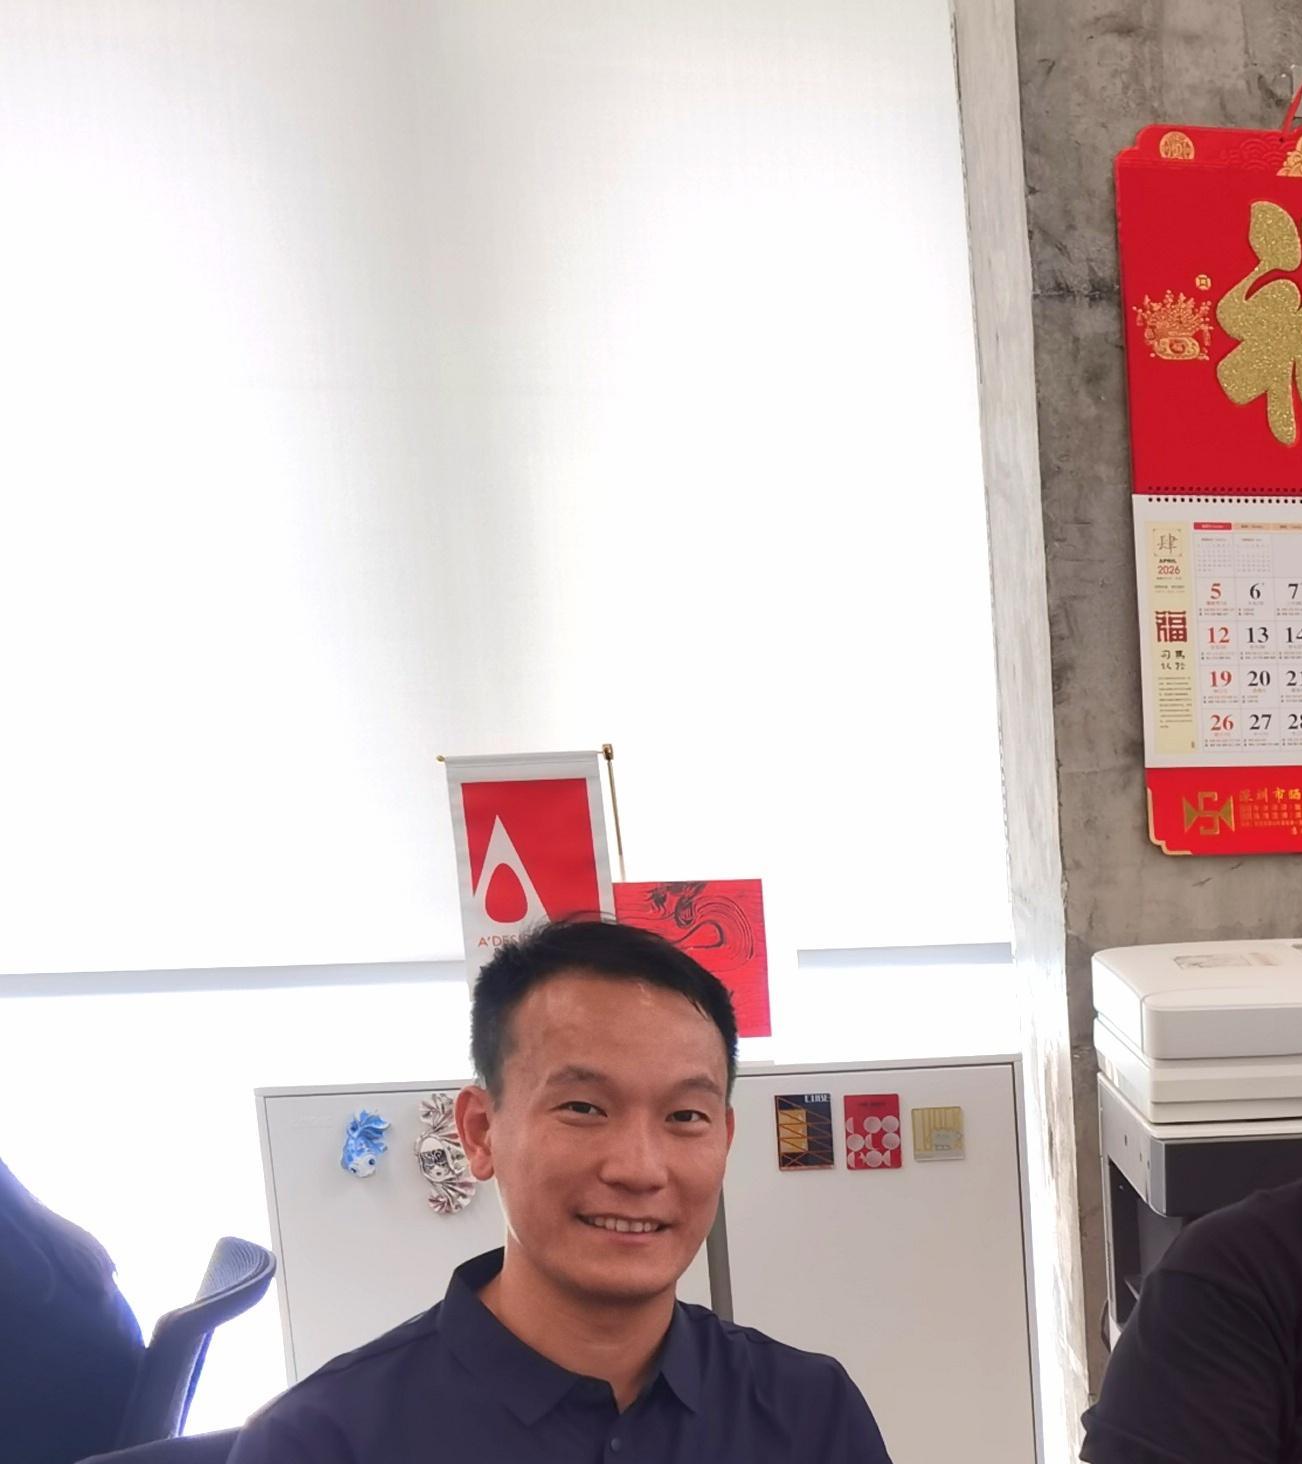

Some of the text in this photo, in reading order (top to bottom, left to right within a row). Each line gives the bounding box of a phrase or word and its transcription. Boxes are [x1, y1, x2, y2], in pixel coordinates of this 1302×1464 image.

[1157, 565, 1181, 575] 2026
[1210, 583, 1222, 599] 5
[1250, 583, 1261, 600] 6
[1288, 583, 1299, 600] 7
[1155, 611, 1188, 643] 福
[1208, 627, 1230, 643] 12
[1247, 627, 1269, 643] 13
[1210, 671, 1232, 687] 19
[1247, 670, 1271, 687] 20
[1210, 714, 1234, 731] 26
[1249, 714, 1272, 730] 27
